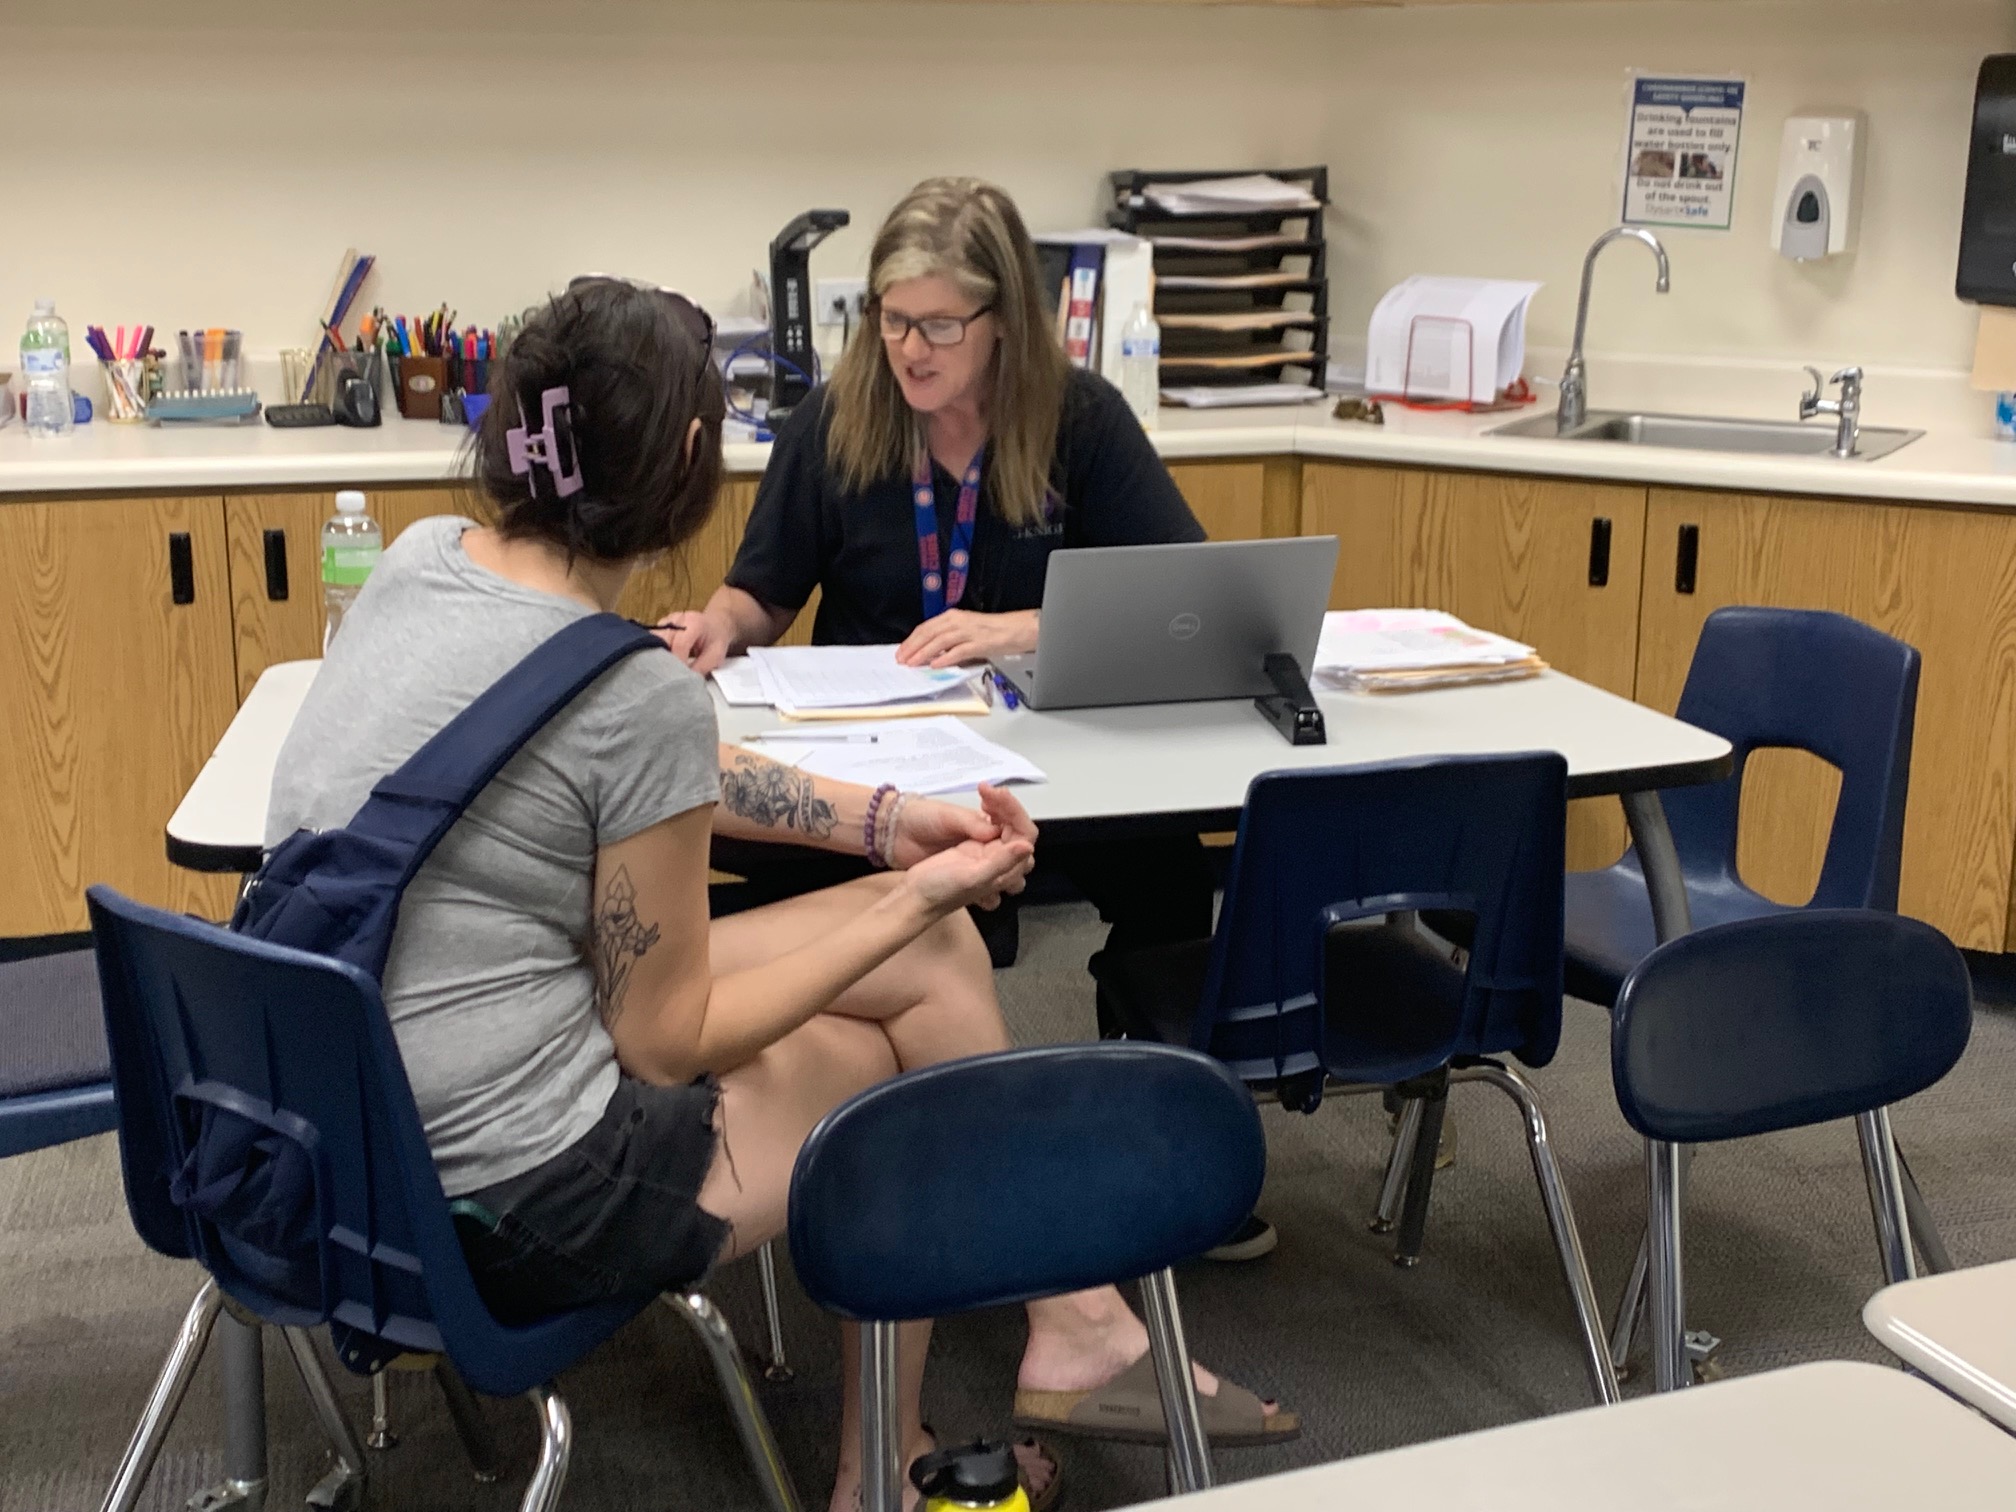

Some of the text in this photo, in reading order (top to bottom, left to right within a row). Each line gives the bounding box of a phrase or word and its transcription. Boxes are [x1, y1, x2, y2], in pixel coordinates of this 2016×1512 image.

[1637, 113, 1682, 125] Drinking
[1647, 128, 1724, 138] are used to fill
[1634, 140, 1664, 148] water
[1668, 141, 1705, 150] bottles
[1637, 178, 1723, 192] Do not drink out
[1645, 191, 1656, 201] of
[1659, 192, 1677, 202] the
